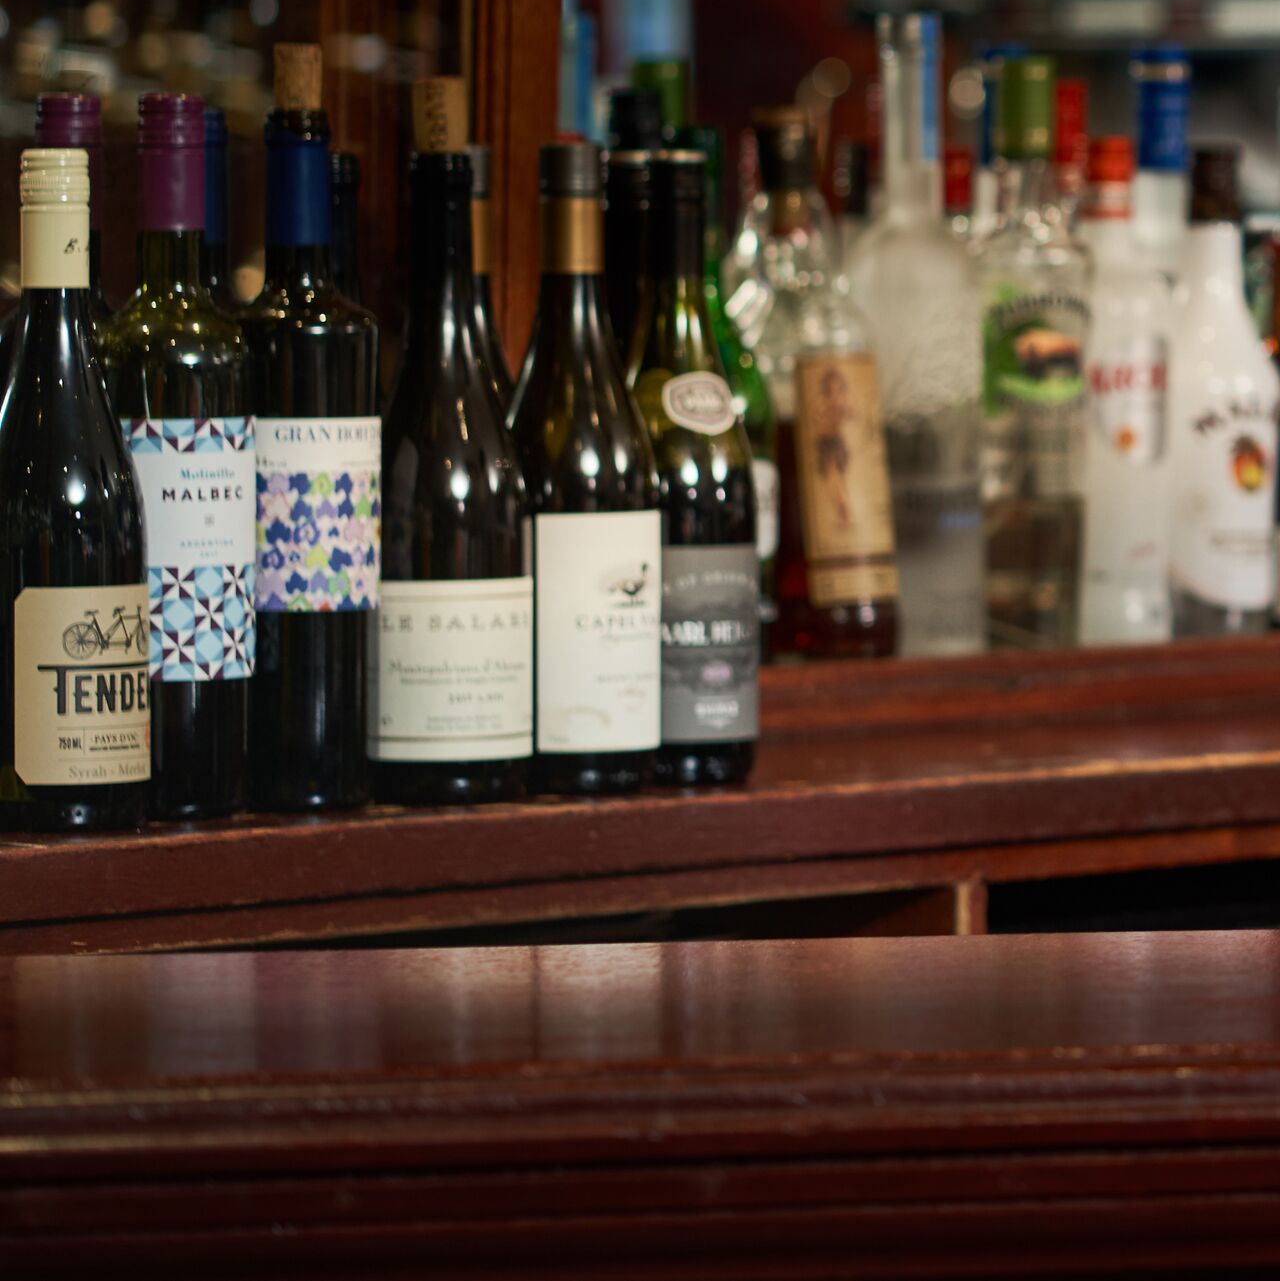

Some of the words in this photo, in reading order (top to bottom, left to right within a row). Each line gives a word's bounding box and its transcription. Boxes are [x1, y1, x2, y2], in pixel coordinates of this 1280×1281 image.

[275, 424, 331, 443] GRAN
[162, 485, 243, 502] MALBEC
[38, 661, 149, 716] TENDE
[69, 763, 108, 780] Syrah
